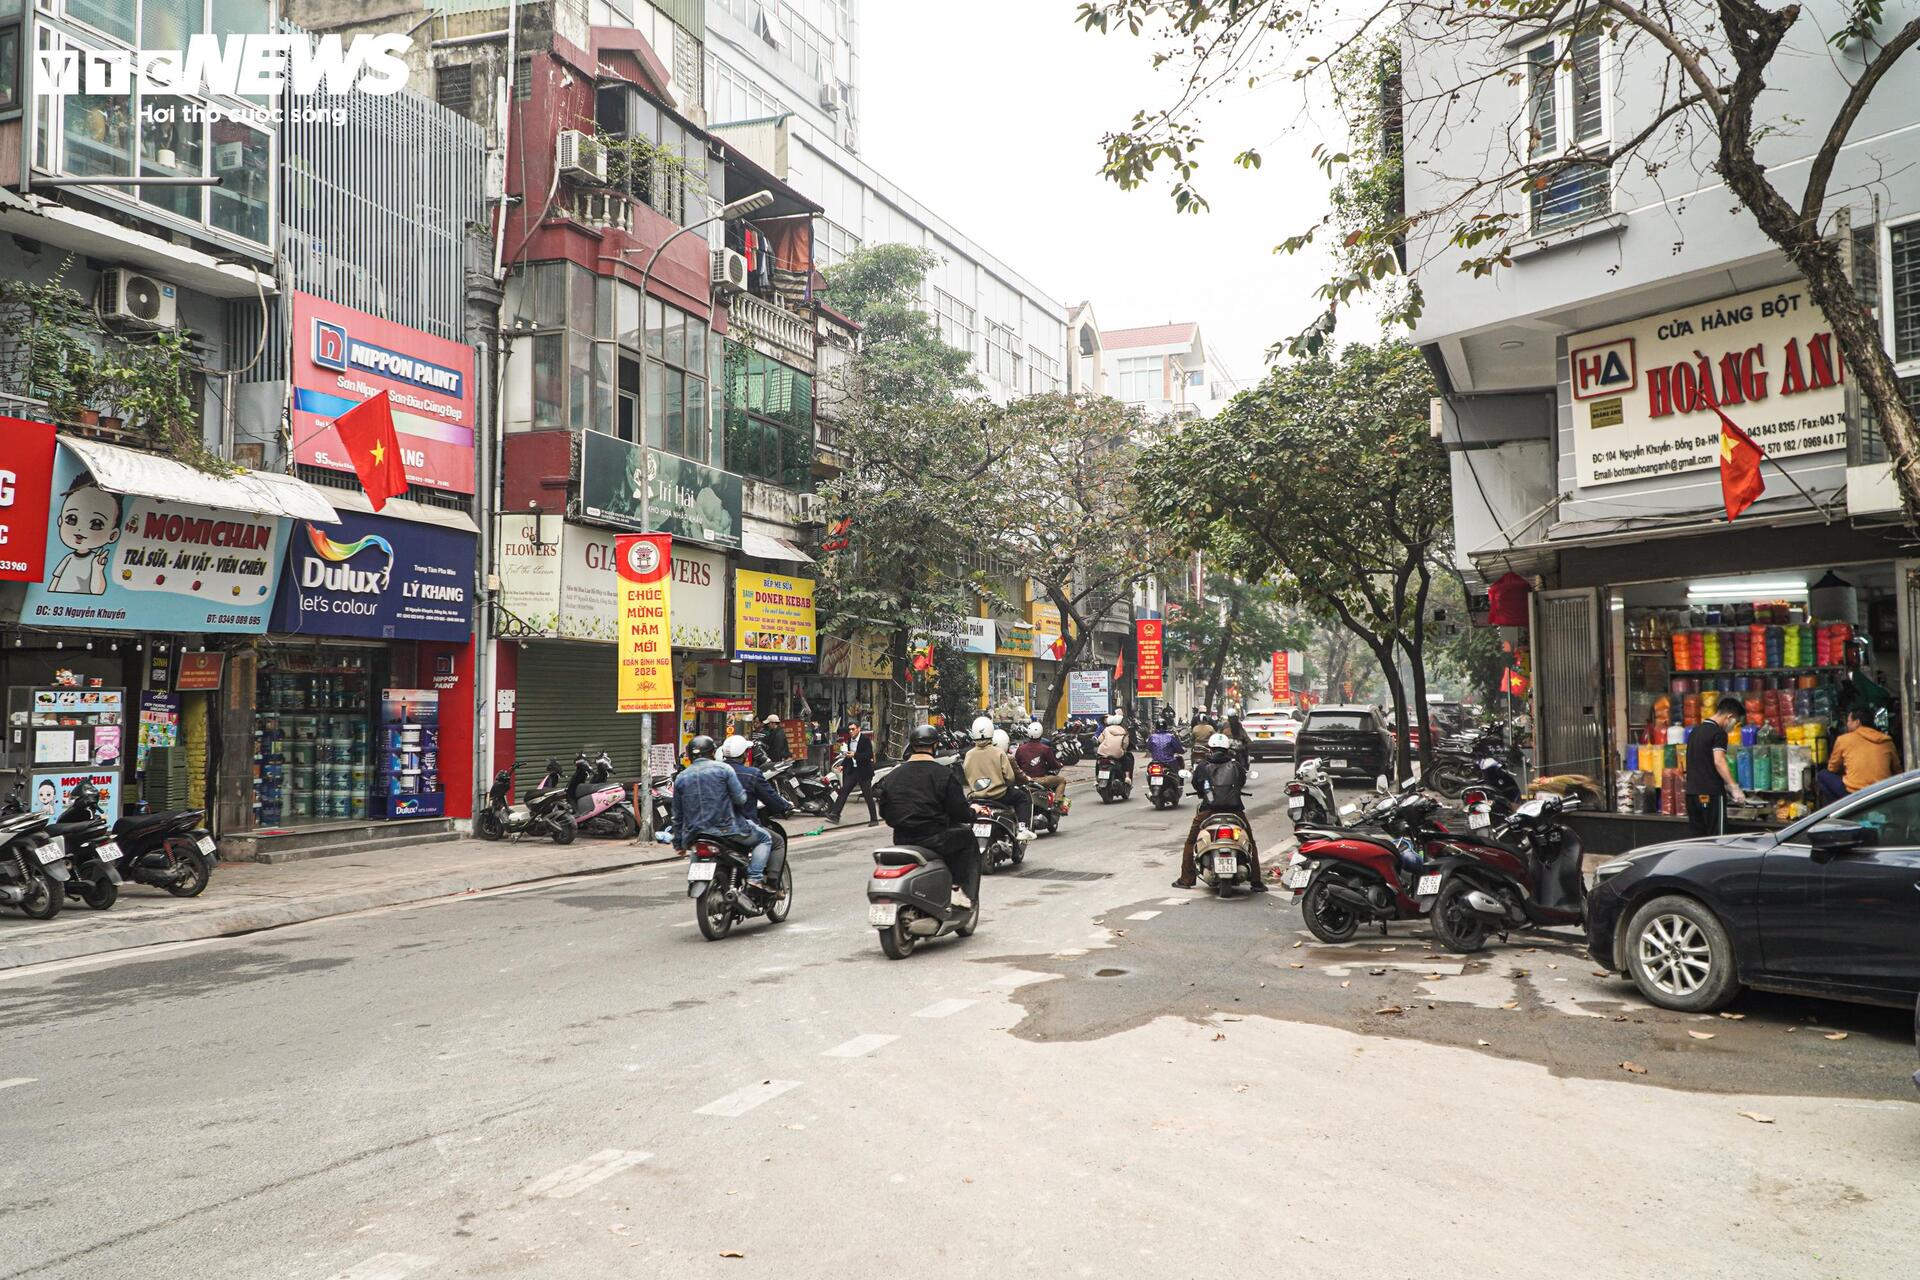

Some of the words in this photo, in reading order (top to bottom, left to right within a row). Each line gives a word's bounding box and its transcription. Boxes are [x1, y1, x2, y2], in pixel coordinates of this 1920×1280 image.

[1657, 318, 1694, 341] CỬA
[1701, 306, 1753, 332] HÀNG
[1761, 294, 1801, 319] BỘT
[351, 343, 413, 379] NIPPON
[413, 361, 459, 392] PAINT
[337, 375, 356, 390] Sơn
[1645, 342, 1768, 419] HOÀNG
[1747, 427, 1761, 437] 043
[1762, 423, 1777, 434] 843
[1778, 421, 1796, 433] 8315
[1768, 443, 1781, 454] 570
[1783, 439, 1796, 451] 182
[1803, 435, 1821, 448] 0969
[315, 451, 328, 465] 95
[1605, 451, 1617, 461] 104
[658, 479, 673, 503] Trí
[675, 485, 694, 509] Hải
[143, 512, 272, 551] MOMICHAN
[145, 548, 168, 569] SỮA
[302, 556, 381, 595] Dulux
[414, 564, 428, 574] Trung
[403, 580, 420, 598] LÝ
[421, 584, 463, 602] KHANG
[627, 588, 662, 601] CHÚC
[332, 598, 378, 616] colour
[755, 591, 784, 605] DONER
[785, 595, 811, 608] KEBAB
[53, 606, 64, 617] 93
[627, 605, 663, 618] MỪNG
[631, 623, 659, 636] NĂM
[634, 640, 657, 653] MỚI
[433, 675, 459, 683] NIPPON
[634, 667, 657, 676] 2026
[396, 804, 416, 815] Dulux
